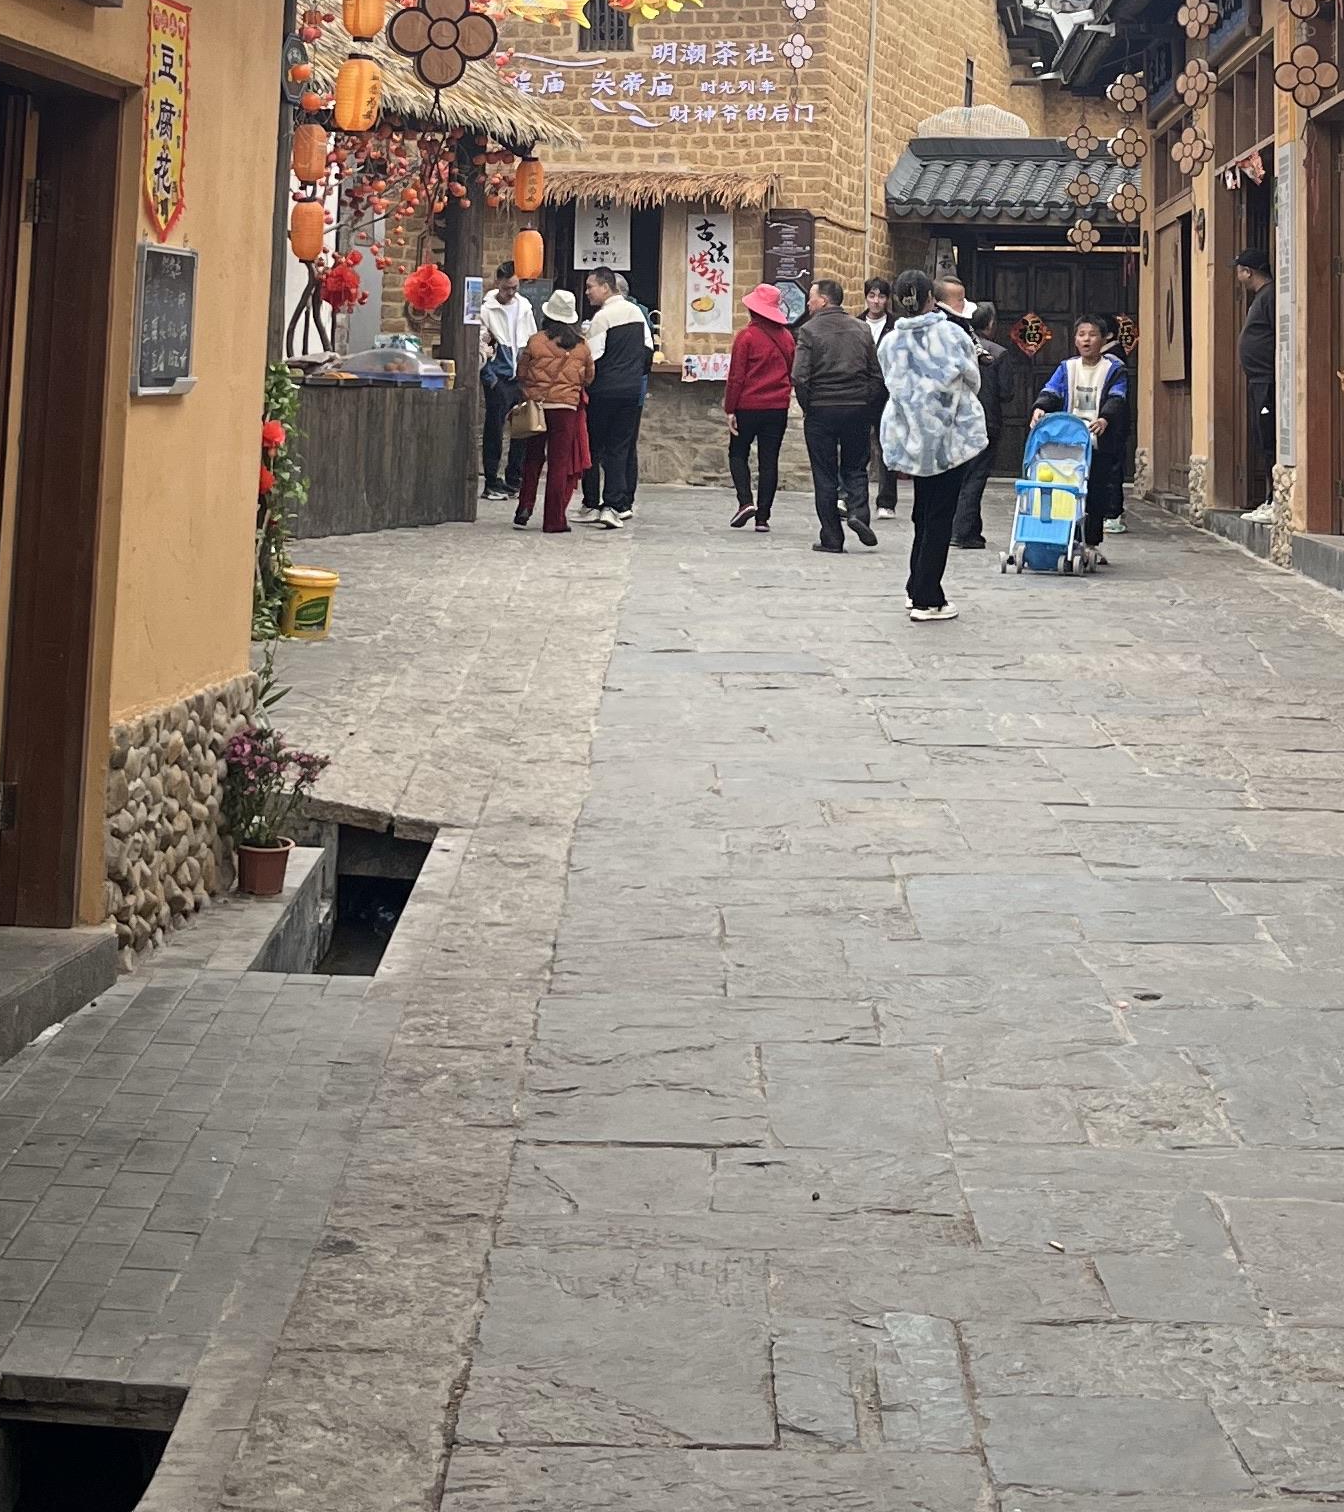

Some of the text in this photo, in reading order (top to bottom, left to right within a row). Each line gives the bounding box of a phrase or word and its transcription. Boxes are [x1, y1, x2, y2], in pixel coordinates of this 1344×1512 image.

[651, 40, 774, 66] 明潮茶社
[591, 71, 673, 97] 关帝庙
[700, 79, 775, 95] 时光列车
[154, 43, 177, 194] 豆腐花
[669, 104, 814, 124] 财神爷的后门
